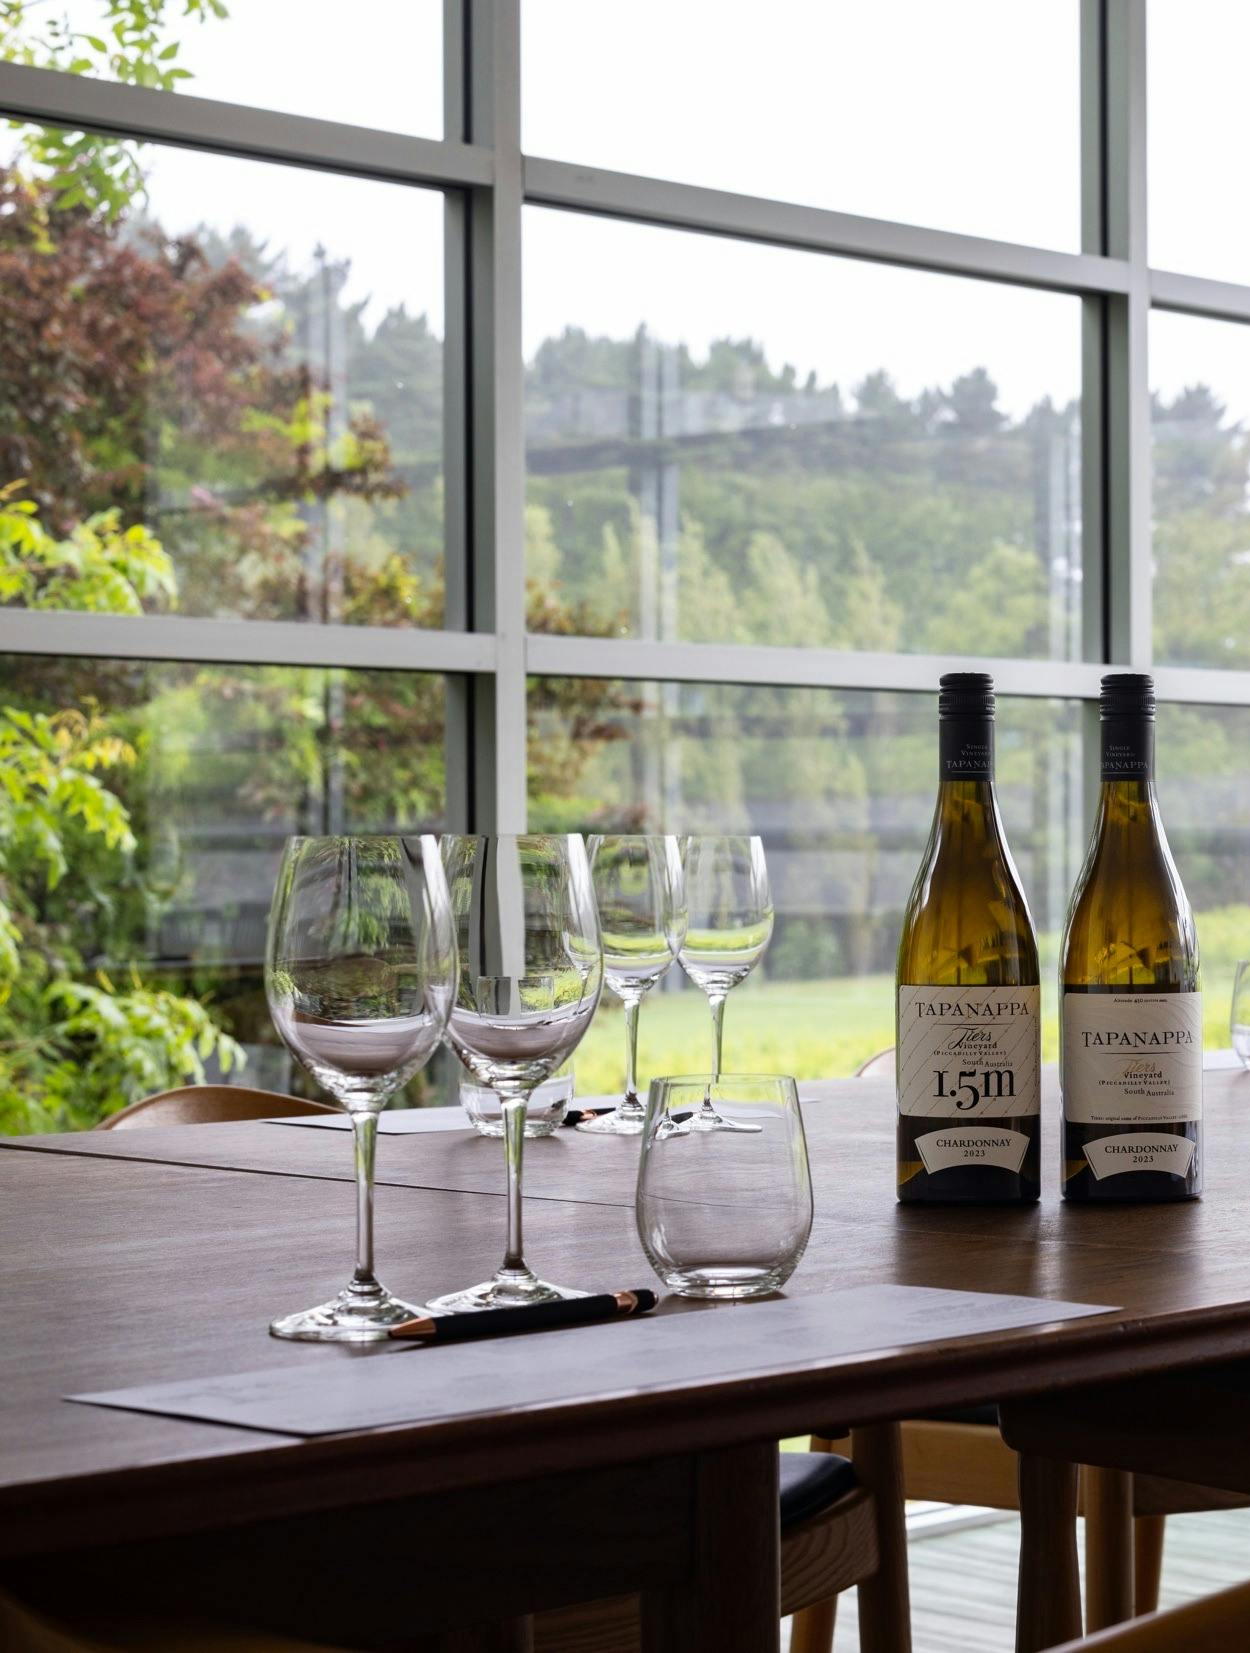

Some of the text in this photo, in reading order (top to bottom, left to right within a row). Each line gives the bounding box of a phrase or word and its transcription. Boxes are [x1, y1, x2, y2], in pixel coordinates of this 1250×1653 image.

[915, 1002, 1029, 1018] TAPANAPPA
[948, 1027, 993, 1050] Tiers
[1081, 1031, 1193, 1048] TAPANAPPA
[958, 1042, 998, 1051] Vineyard
[962, 1058, 1013, 1068] South Australia
[1116, 1059, 1157, 1077] Tiers
[1124, 1071, 1162, 1081] Vineyard
[932, 1068, 1017, 1110] 1.5m
[1123, 1088, 1175, 1097] South Australia
[936, 1138, 1012, 1148] CHARDONNAY
[963, 1149, 986, 1158] 2023
[1104, 1144, 1179, 1154] CHARDONNAY
[1132, 1155, 1154, 1163] 2023
